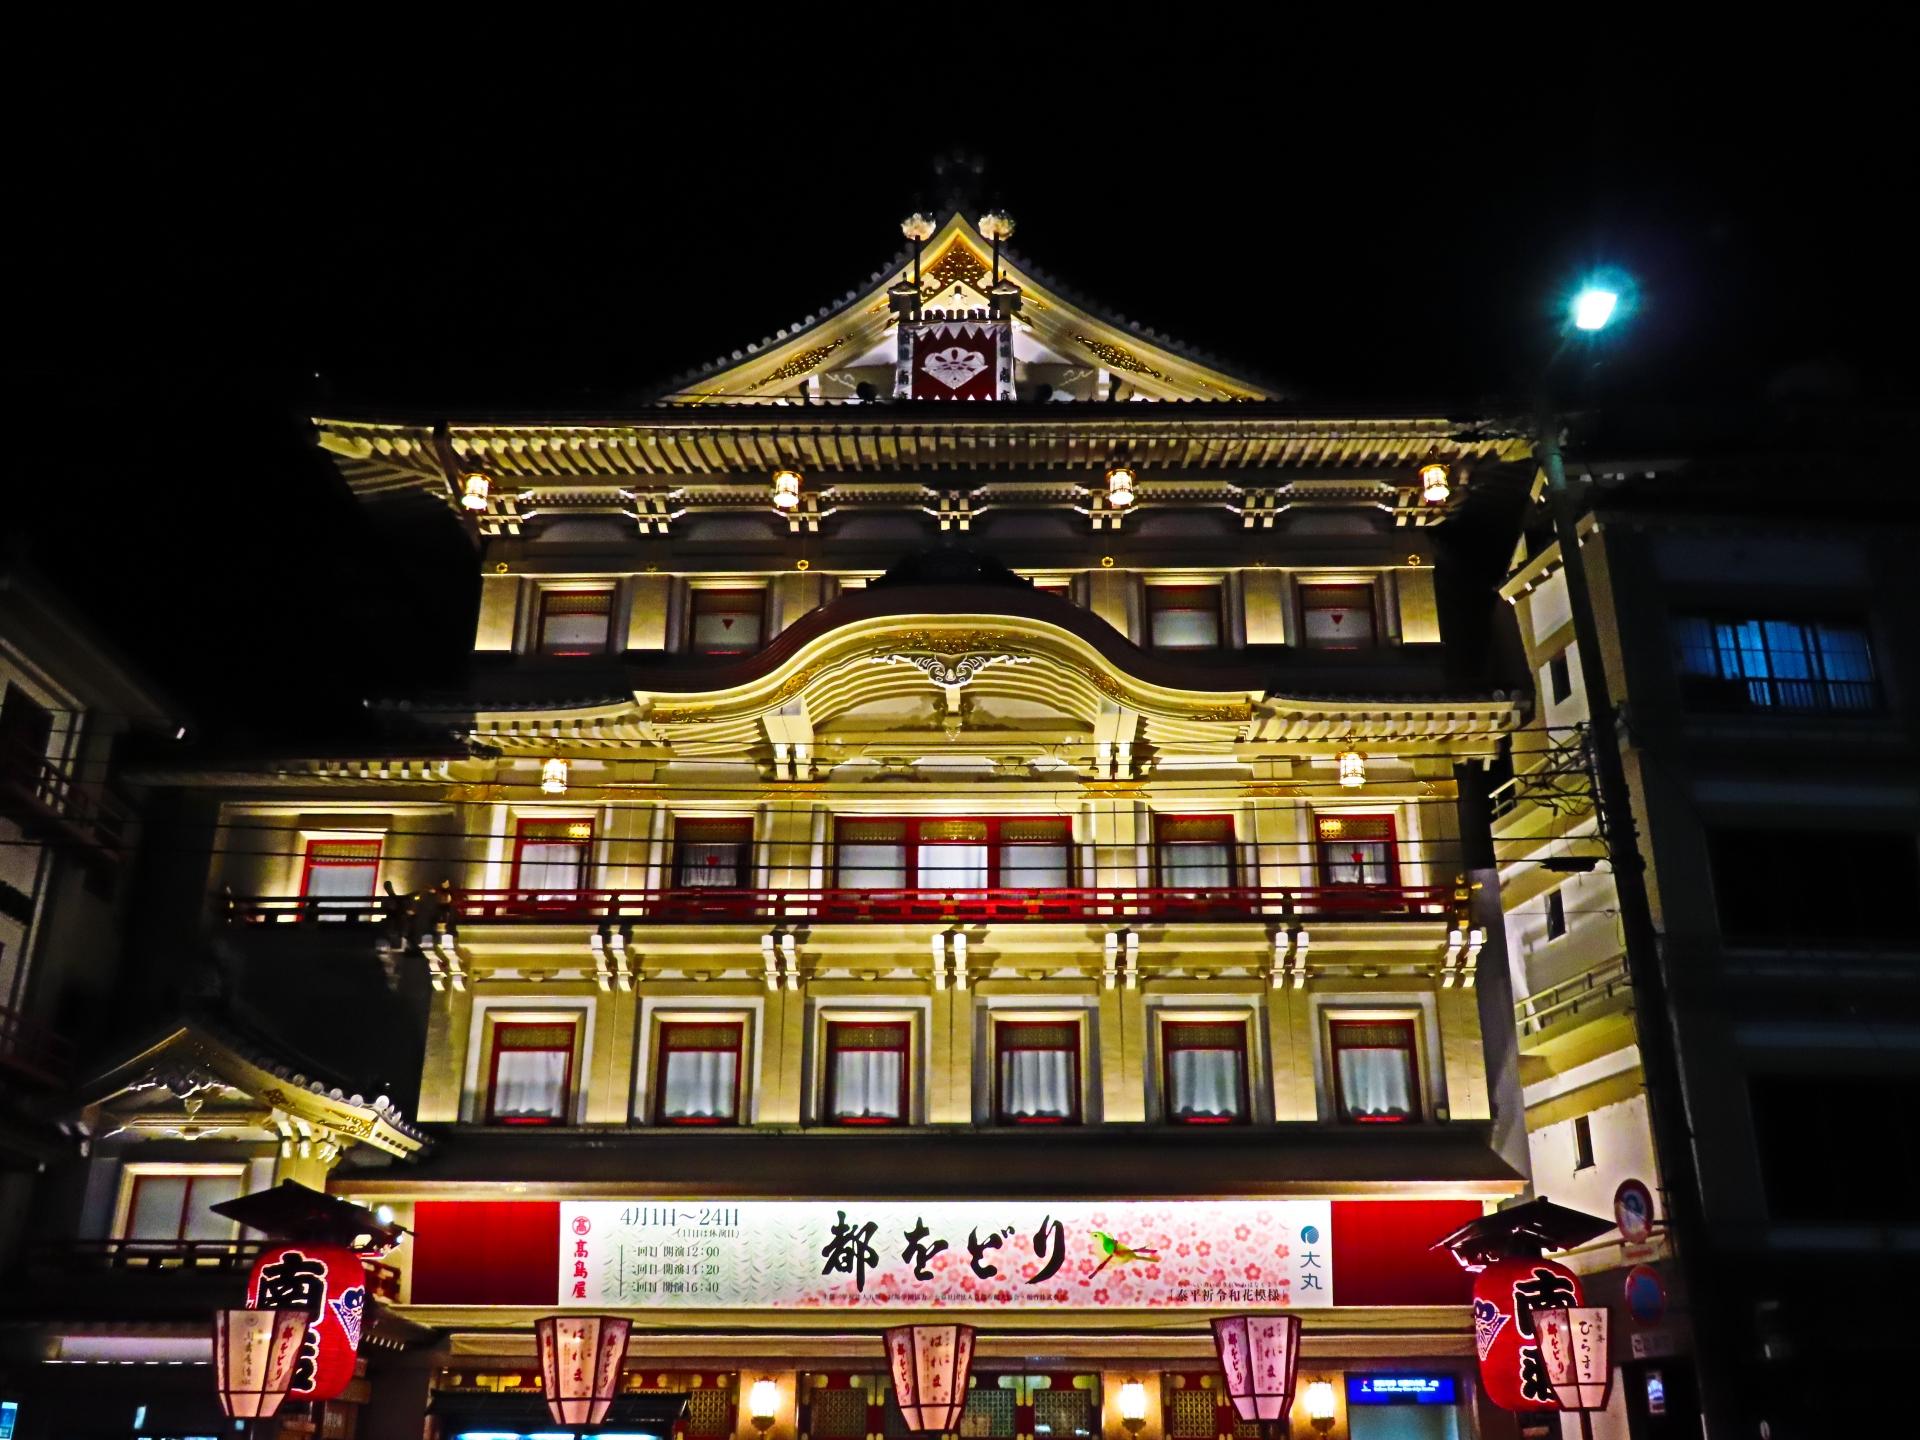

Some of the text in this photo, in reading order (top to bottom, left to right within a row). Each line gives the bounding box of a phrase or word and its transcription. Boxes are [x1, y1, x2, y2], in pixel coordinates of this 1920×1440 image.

[821, 1210, 1065, 1293] 都をどり
[1301, 1251, 1323, 1291] 大丸
